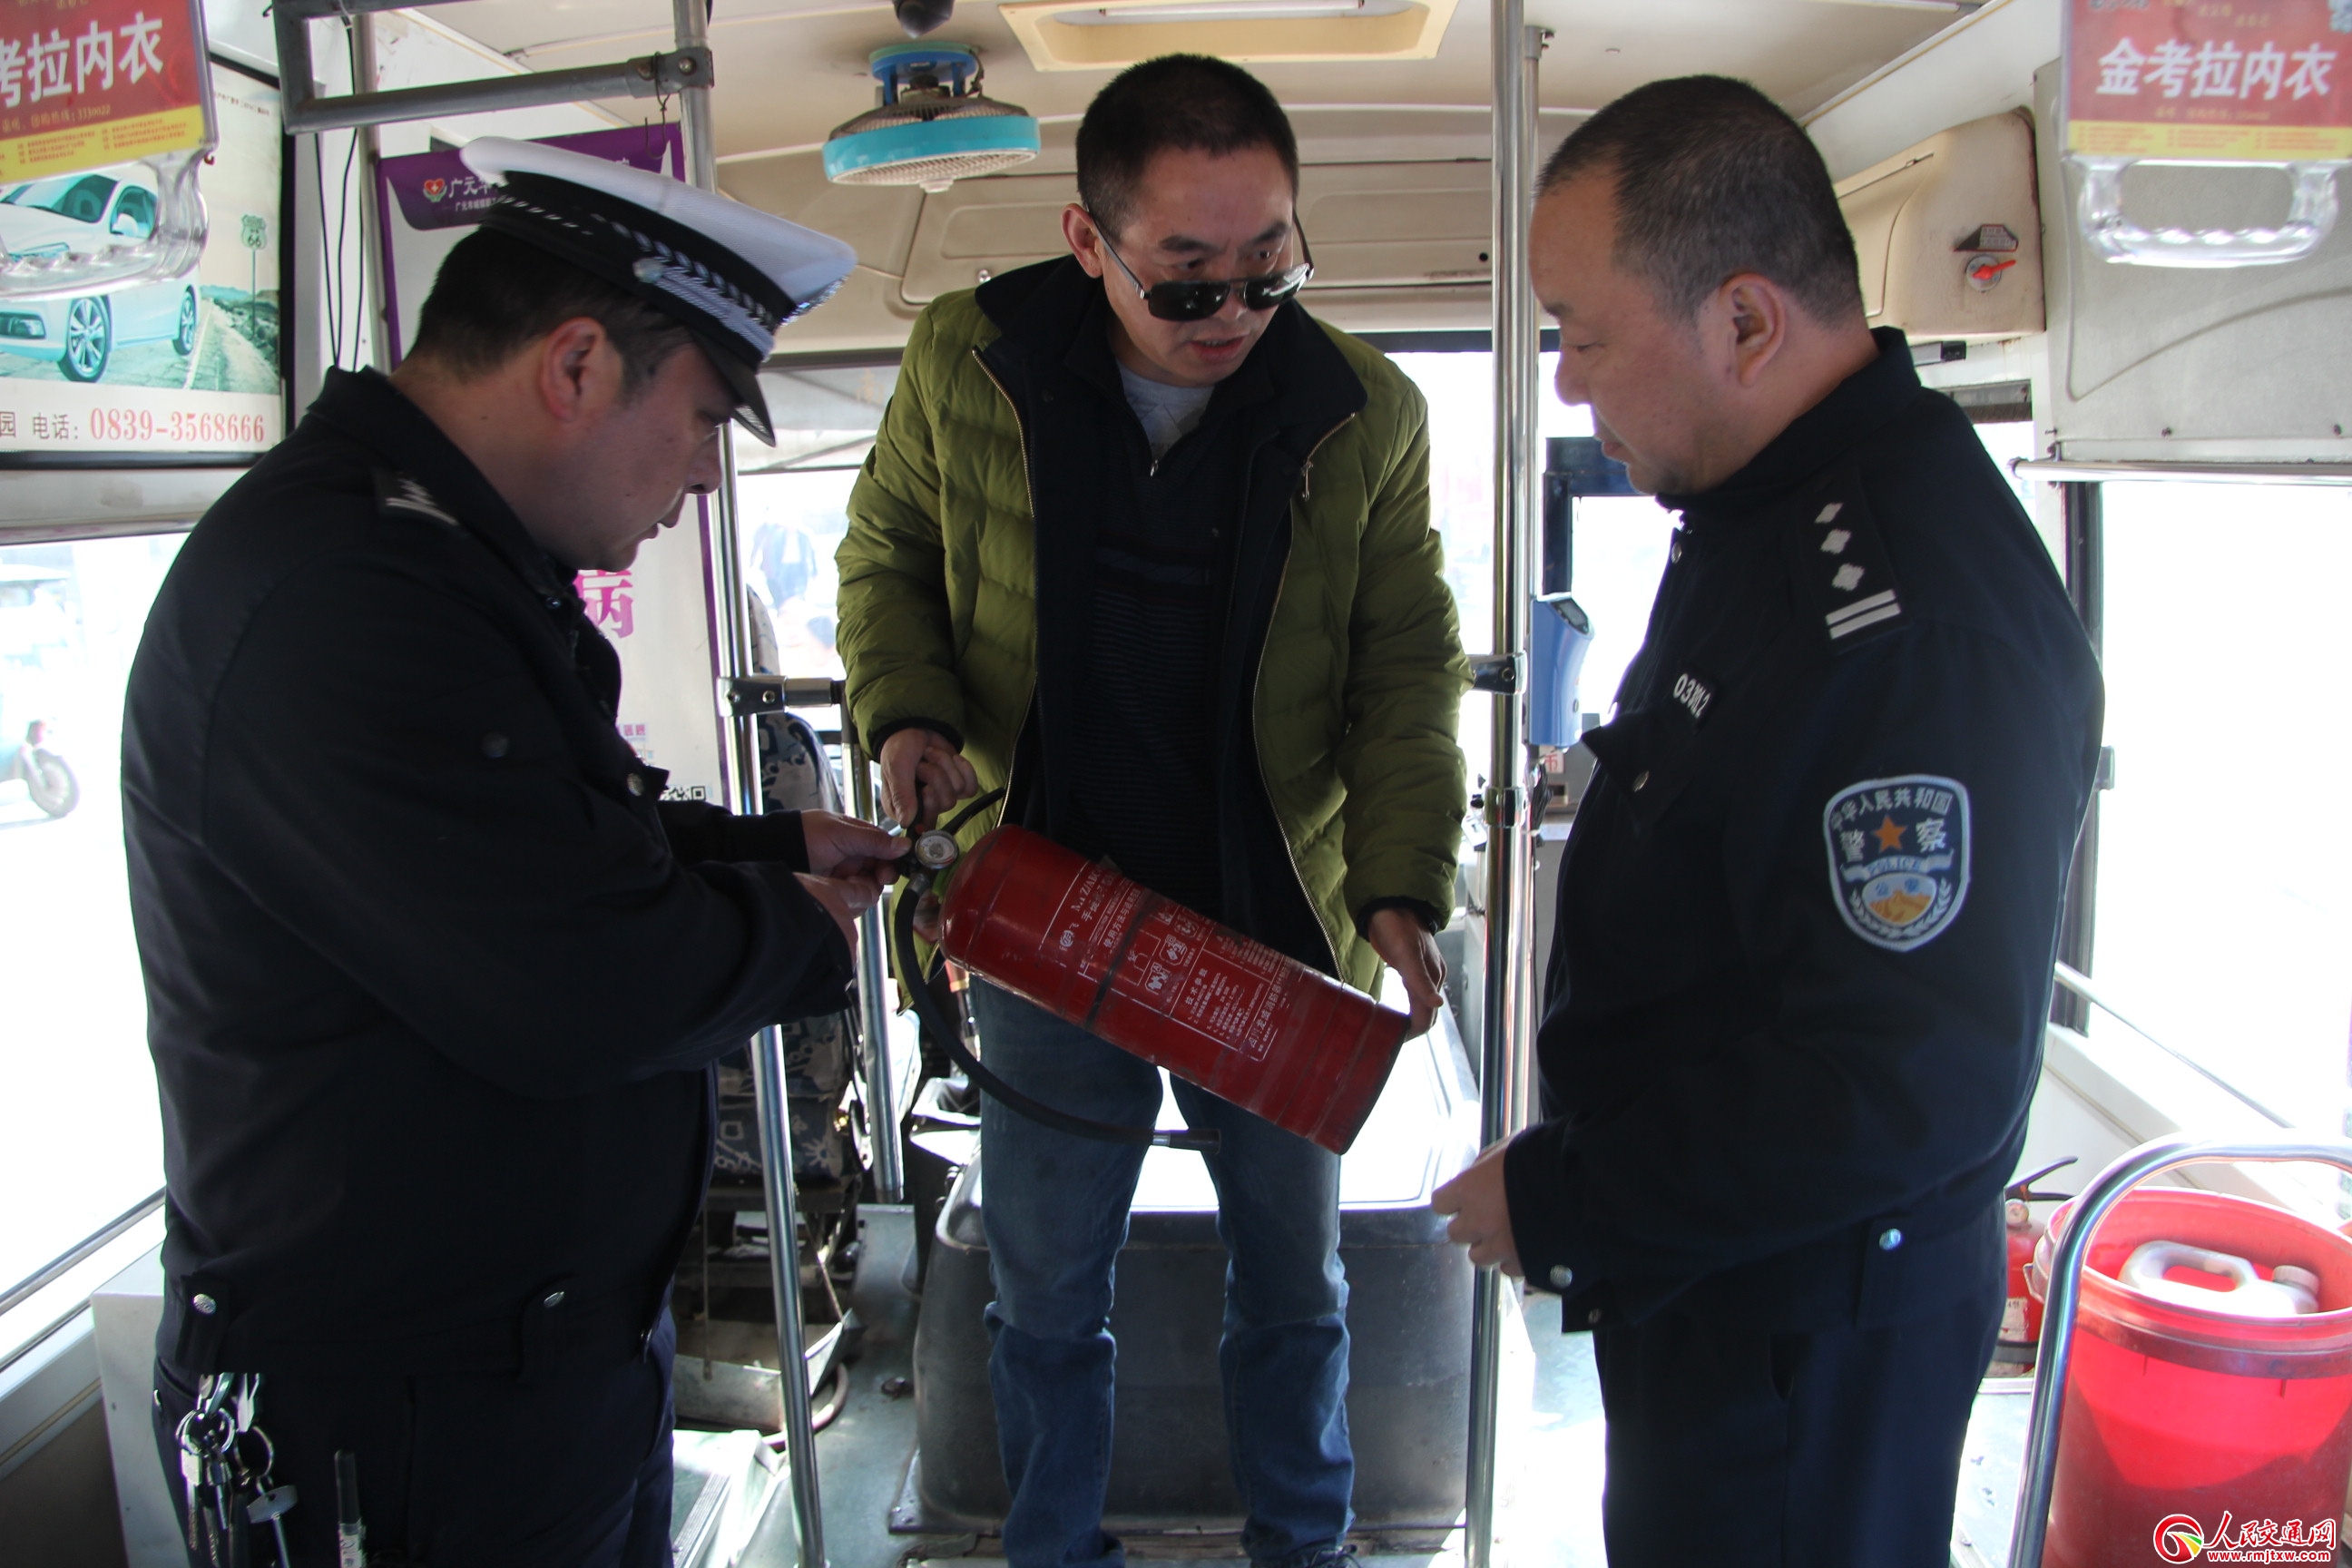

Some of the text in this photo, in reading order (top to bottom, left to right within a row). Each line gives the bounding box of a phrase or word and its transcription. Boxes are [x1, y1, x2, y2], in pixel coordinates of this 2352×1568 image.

[2095, 37, 2337, 101] 金考拉内衣
[248, 234, 261, 247] 66
[90, 407, 265, 443] 0839-3568666
[1830, 787, 1953, 831] 中华人民共和国
